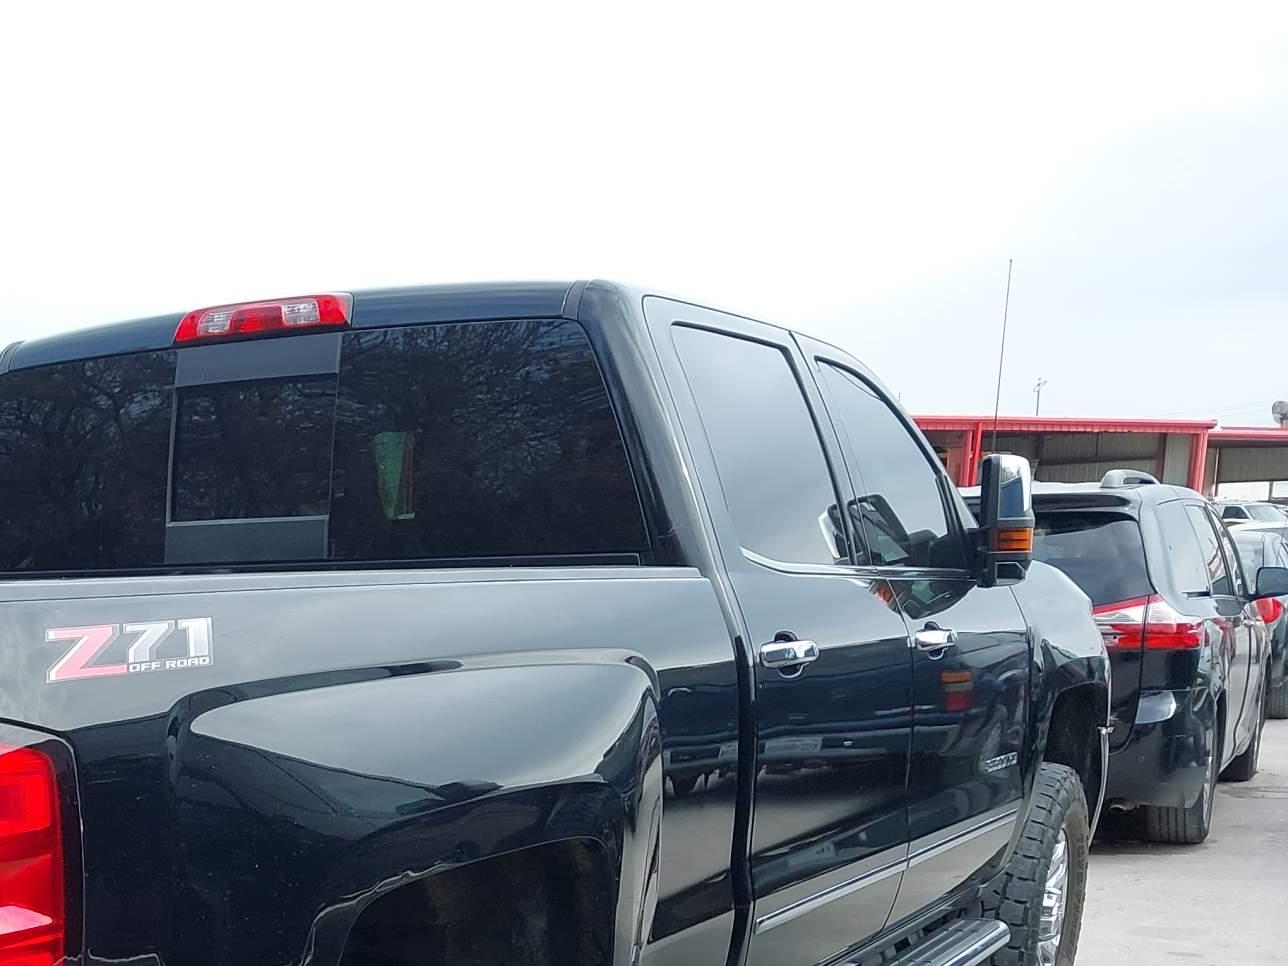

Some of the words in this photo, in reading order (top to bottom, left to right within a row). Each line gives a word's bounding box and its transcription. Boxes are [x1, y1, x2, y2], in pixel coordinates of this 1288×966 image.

[45, 617, 212, 683] Z71
[128, 661, 161, 673] OFF
[165, 656, 210, 669] ROAD
